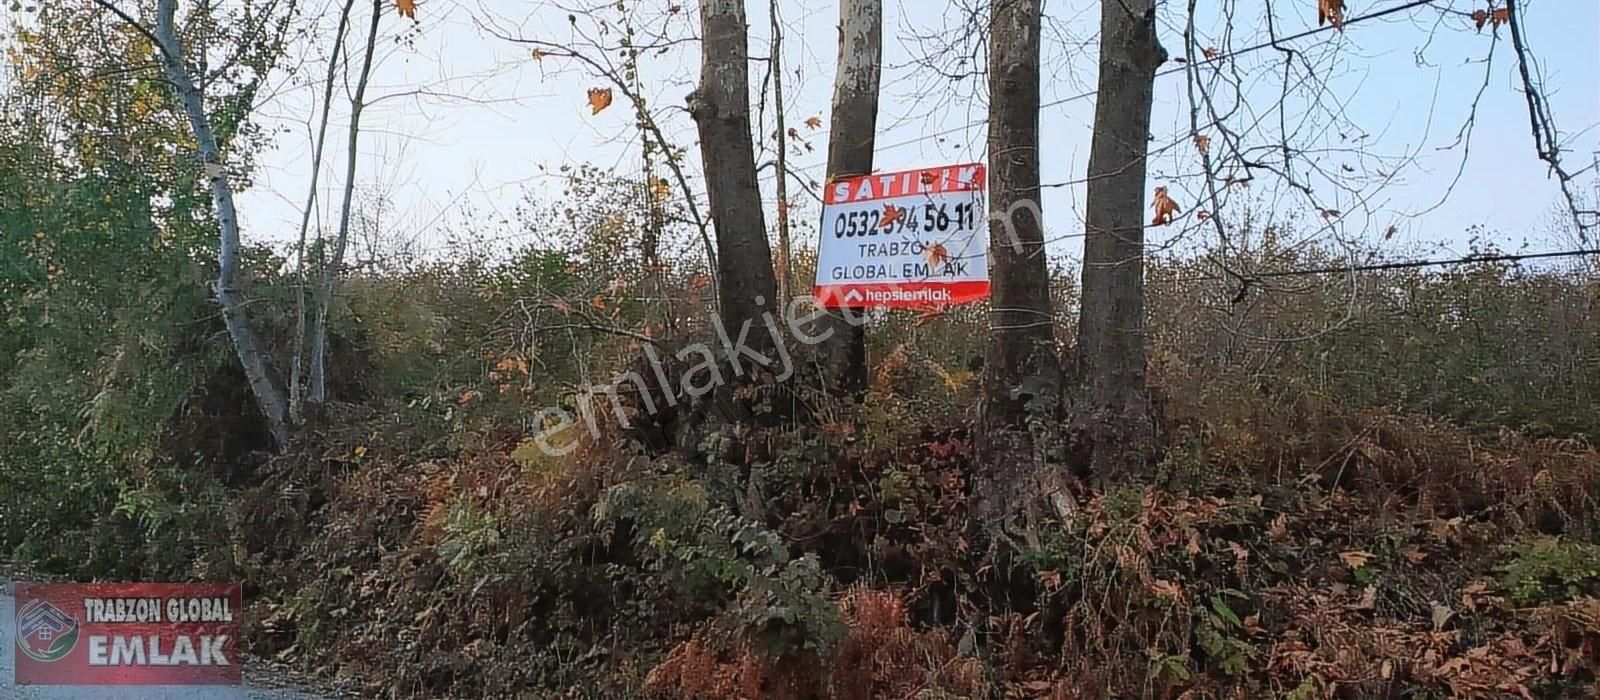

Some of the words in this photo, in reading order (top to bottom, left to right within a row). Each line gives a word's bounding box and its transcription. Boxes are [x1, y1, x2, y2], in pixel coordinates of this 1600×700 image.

[835, 208, 880, 239] 0532
[924, 204, 949, 232] 56
[955, 202, 973, 231] 11
[858, 241, 931, 259] TRABZO
[832, 265, 897, 280] GLOBAL
[866, 287, 952, 303] hepsiemlak
